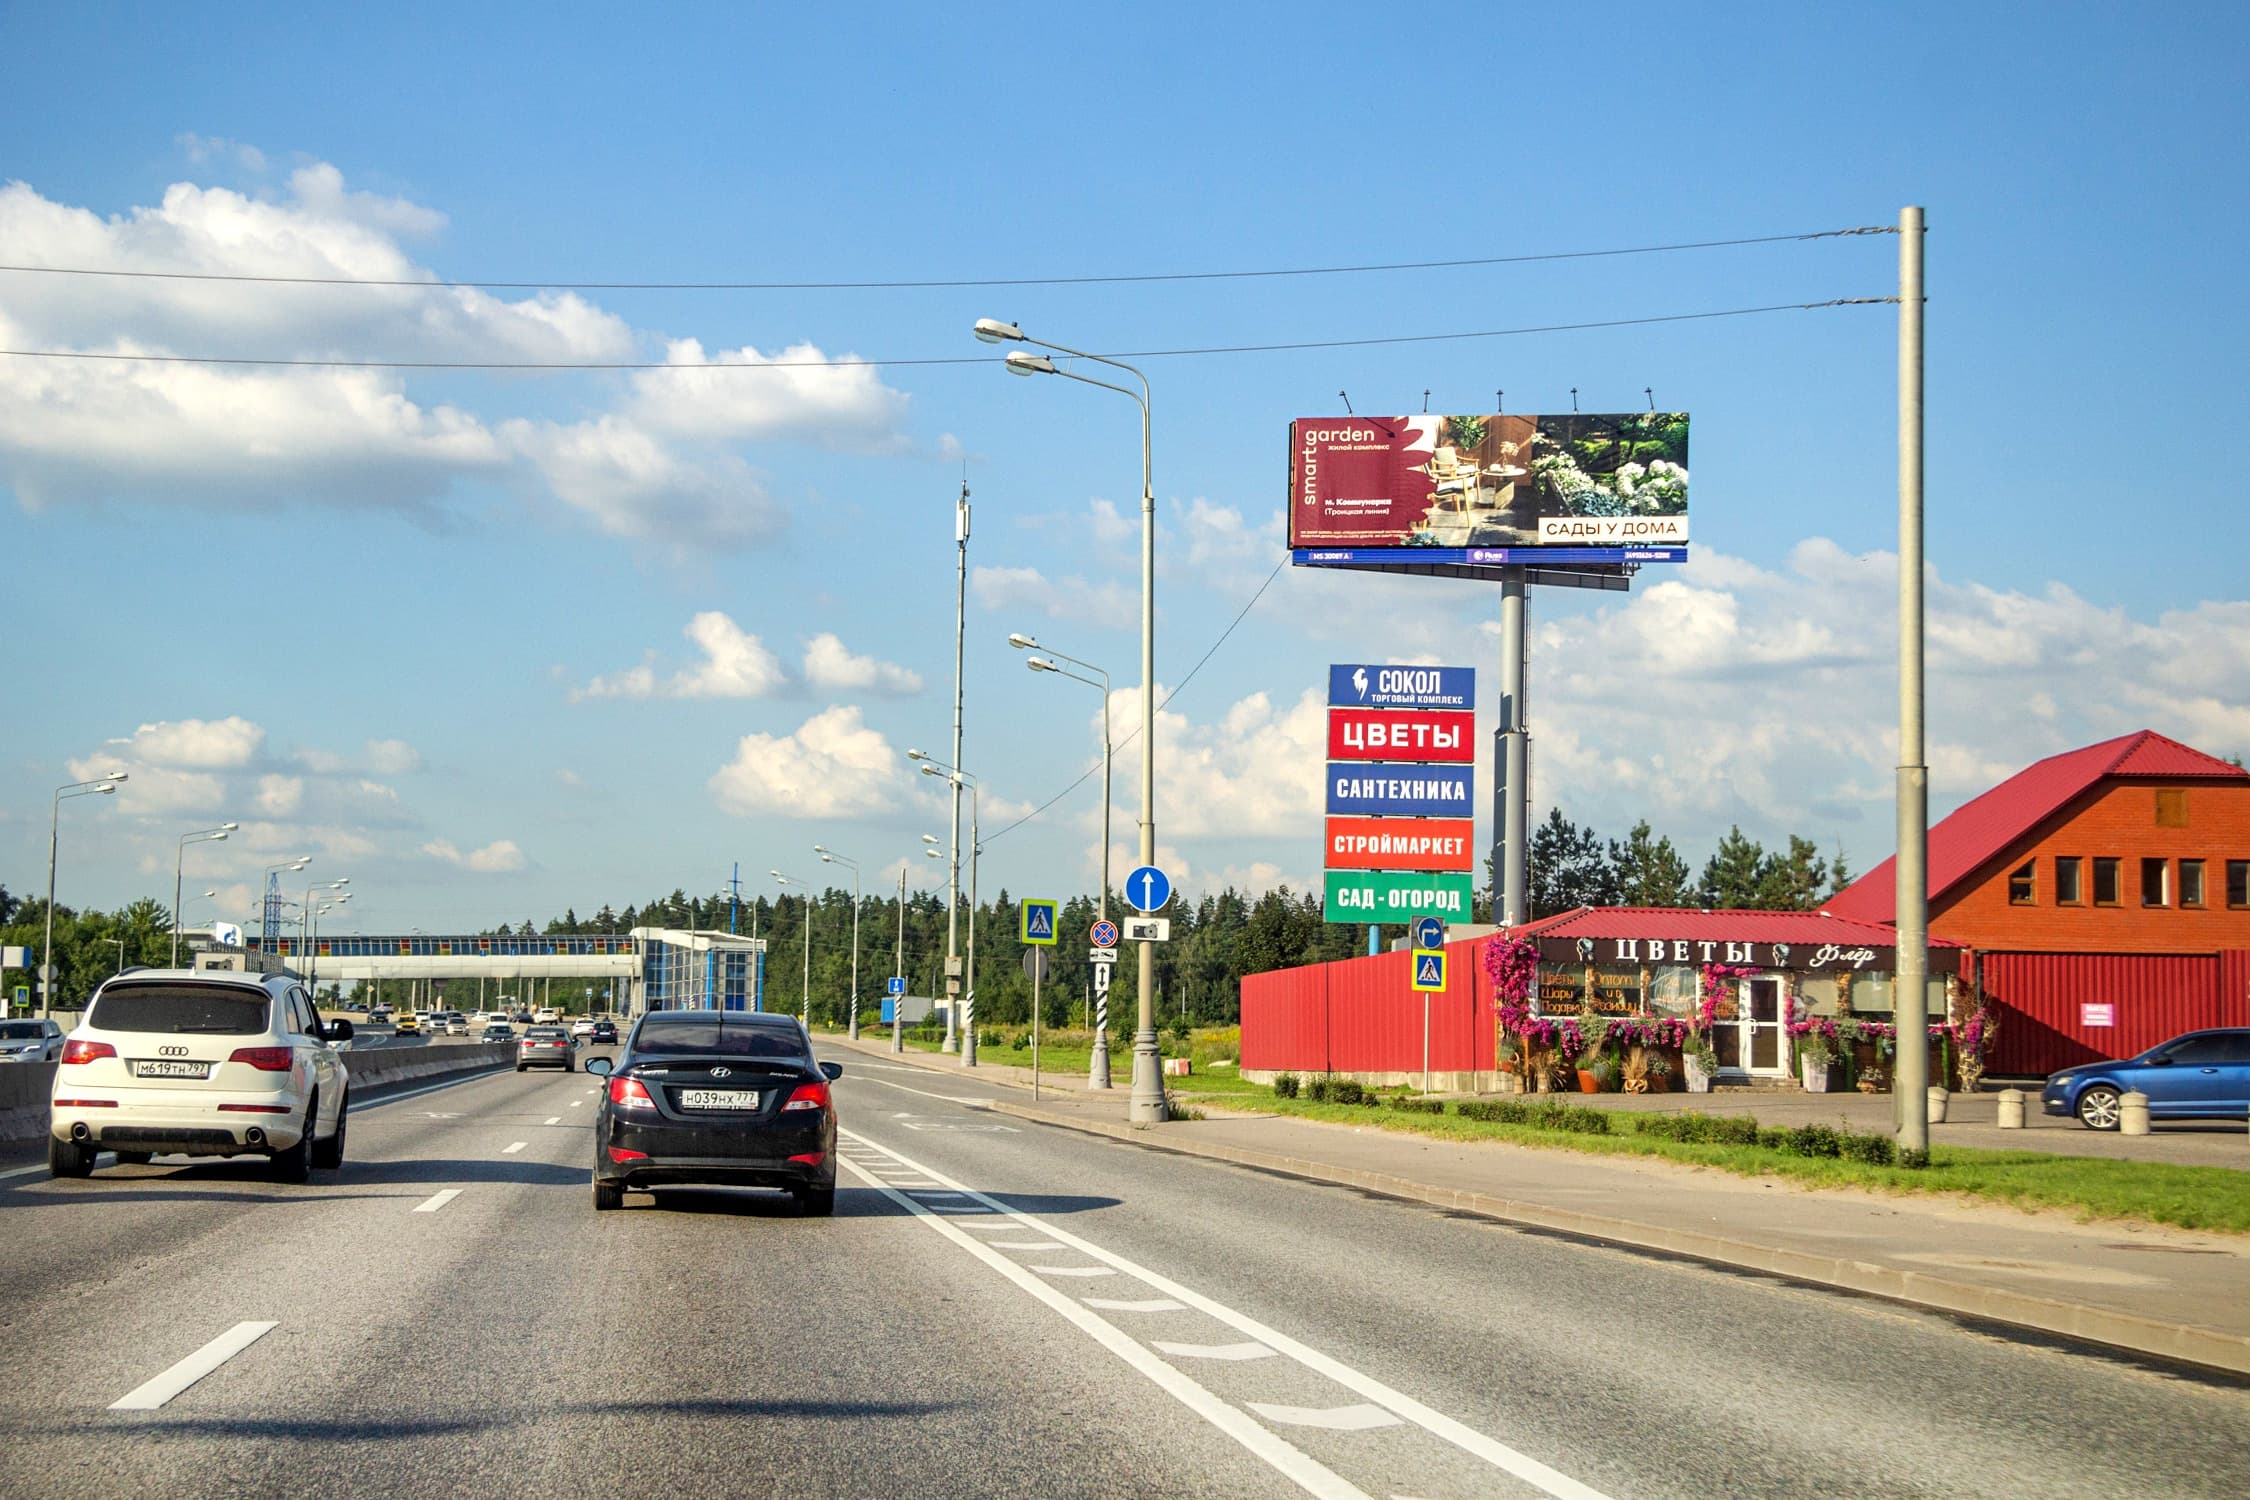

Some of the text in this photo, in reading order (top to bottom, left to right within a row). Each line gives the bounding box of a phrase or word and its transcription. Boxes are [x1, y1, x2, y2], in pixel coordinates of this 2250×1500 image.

[1305, 426, 1375, 446] garden
[1328, 443, 1353, 451] жилой
[1302, 447, 1317, 506] smart
[1546, 522, 1678, 536] САДЫ У ДОМА
[1379, 670, 1441, 694] СОКОЛ
[1371, 694, 1463, 705] ТОРГОВЫЙ КОМПЛЕКС
[1343, 722, 1460, 751] ЦВЕТЫ
[1336, 778, 1465, 801] САНТЕХНИКА
[1334, 834, 1464, 855] СТРОЙМАРКЕТ
[1338, 888, 1375, 910] САД
[1388, 889, 1461, 912] ОГОРОД
[1615, 938, 1754, 963] ЦВЕТЫ
[1541, 971, 1576, 987] Цветы
[1541, 987, 1574, 1001] Шары
[188, 1063, 205, 1073] 797
[736, 1092, 755, 1102] 777
